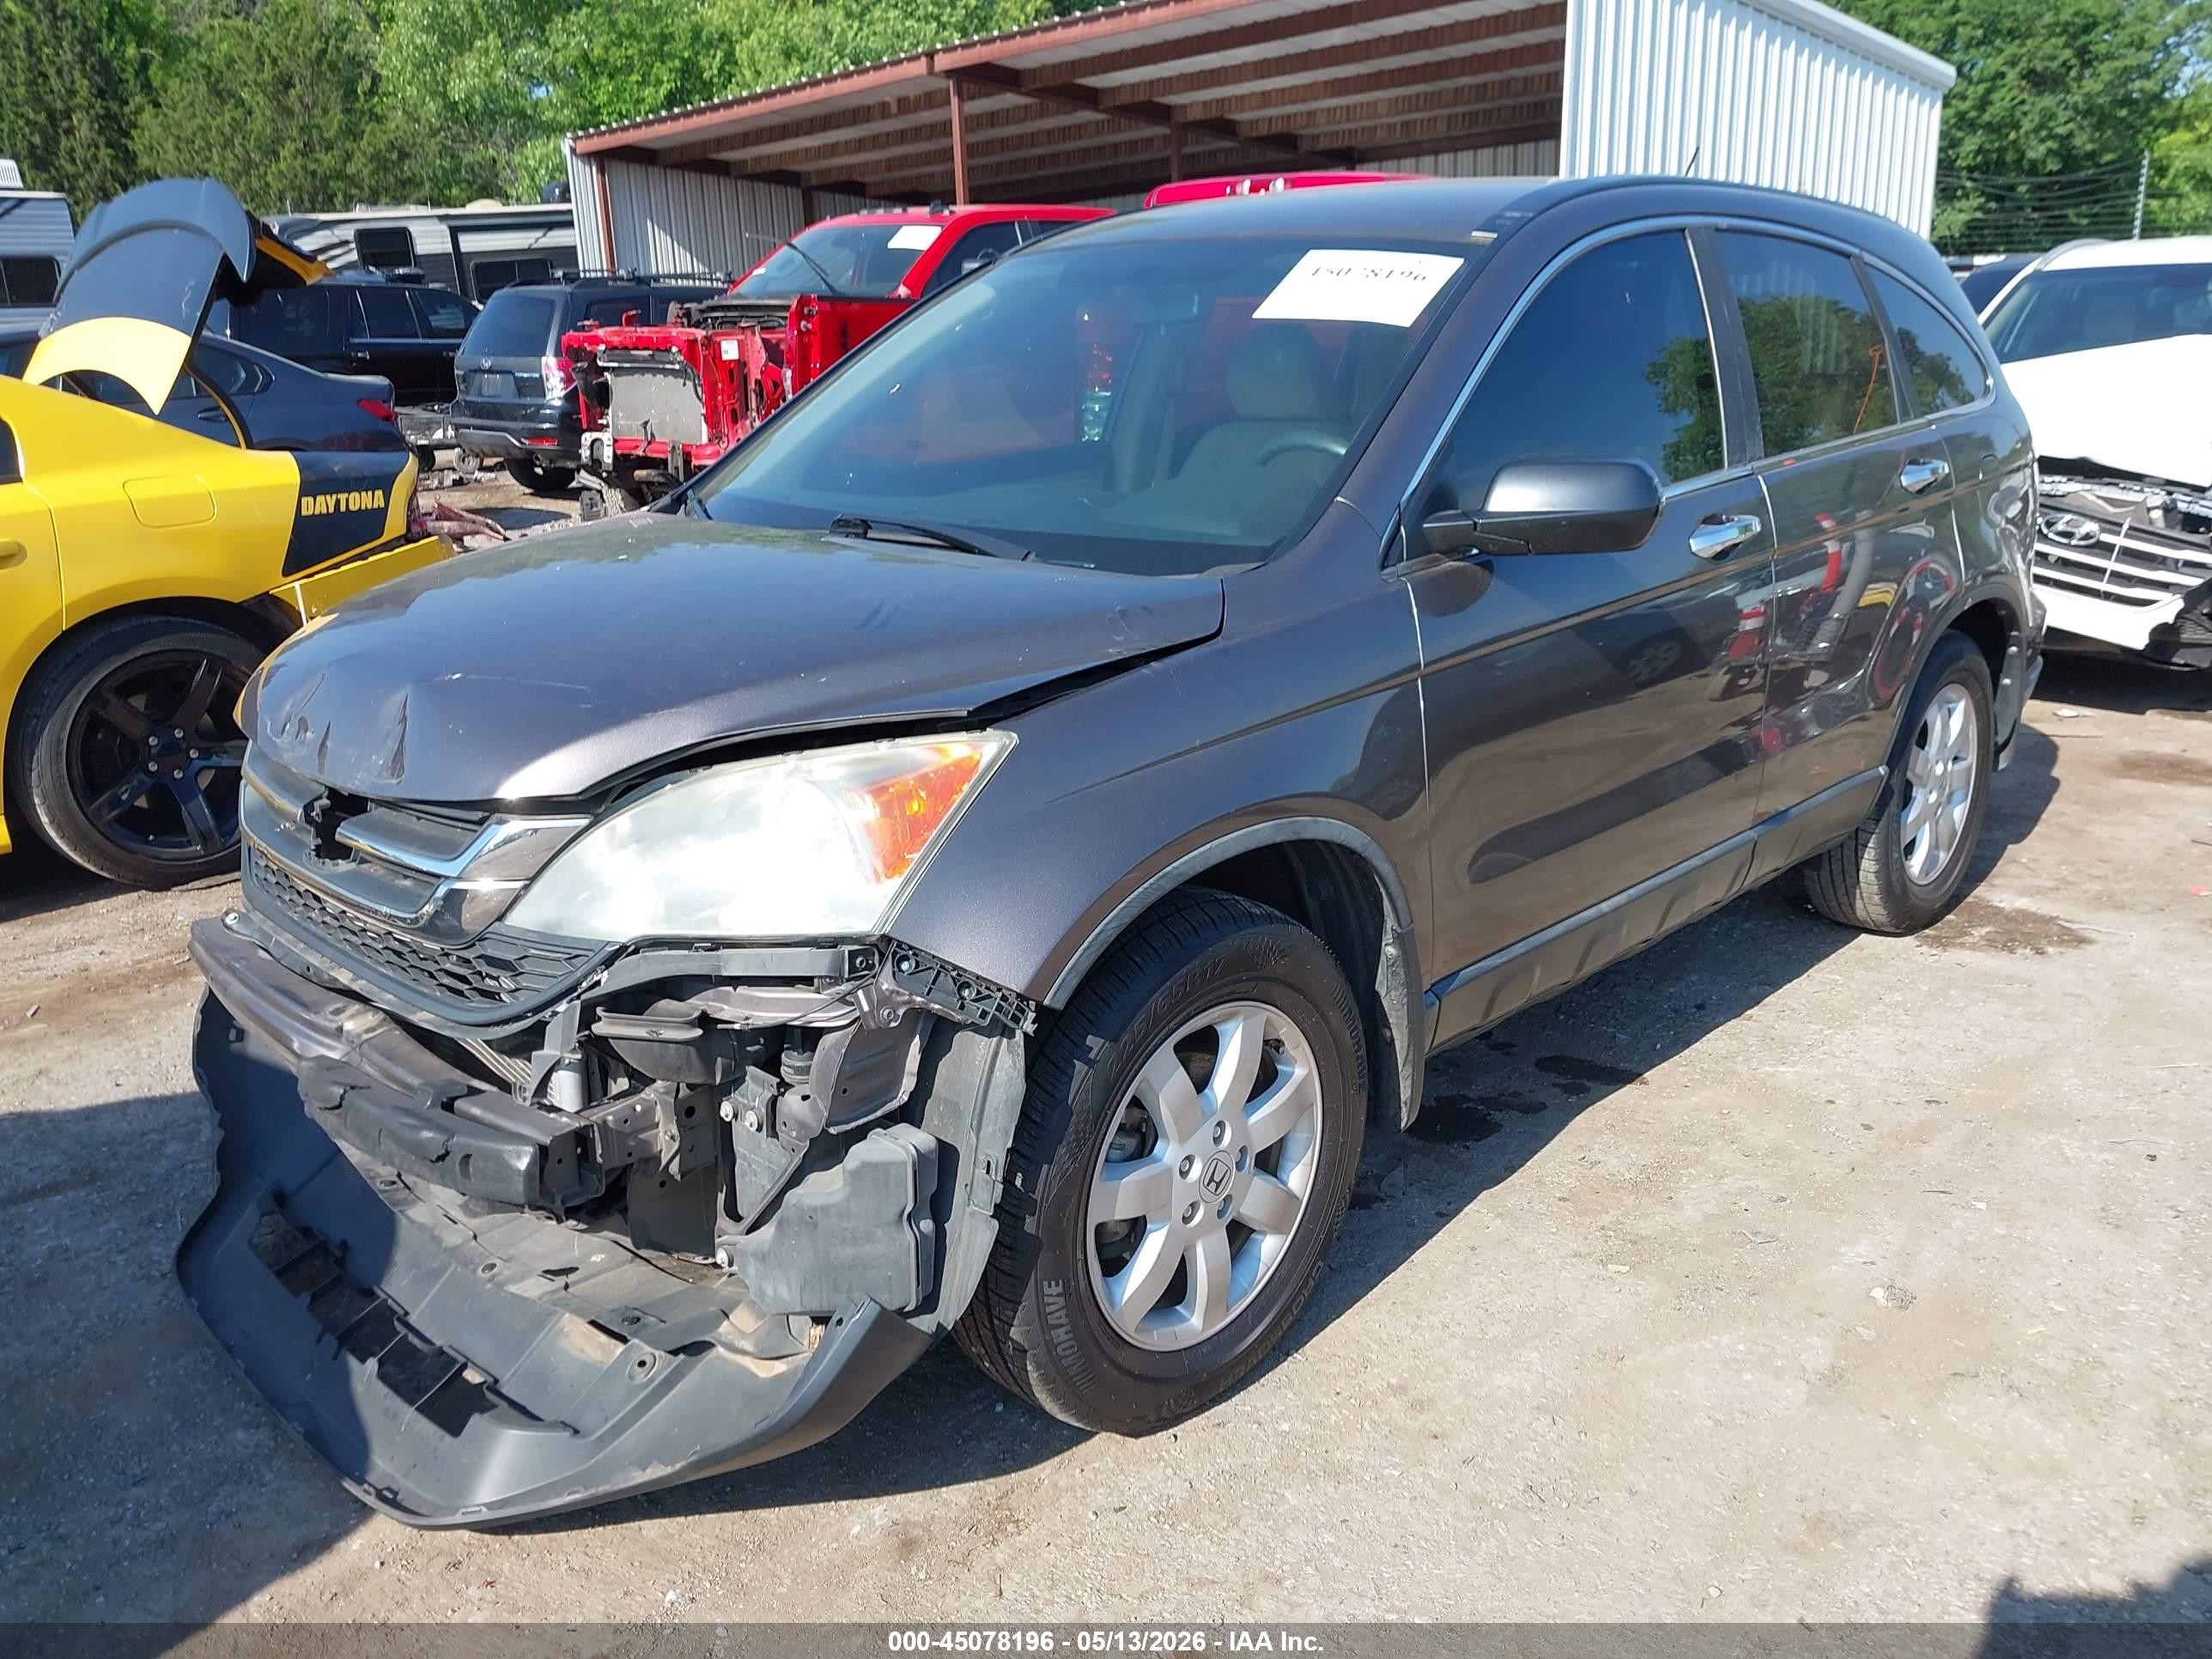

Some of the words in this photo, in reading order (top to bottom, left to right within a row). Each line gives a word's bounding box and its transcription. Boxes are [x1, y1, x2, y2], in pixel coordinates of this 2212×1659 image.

[1310, 266, 1427, 282] 08196
[301, 489, 386, 517] DAYTONA
[1042, 1279, 1091, 1381] MOHAVE
